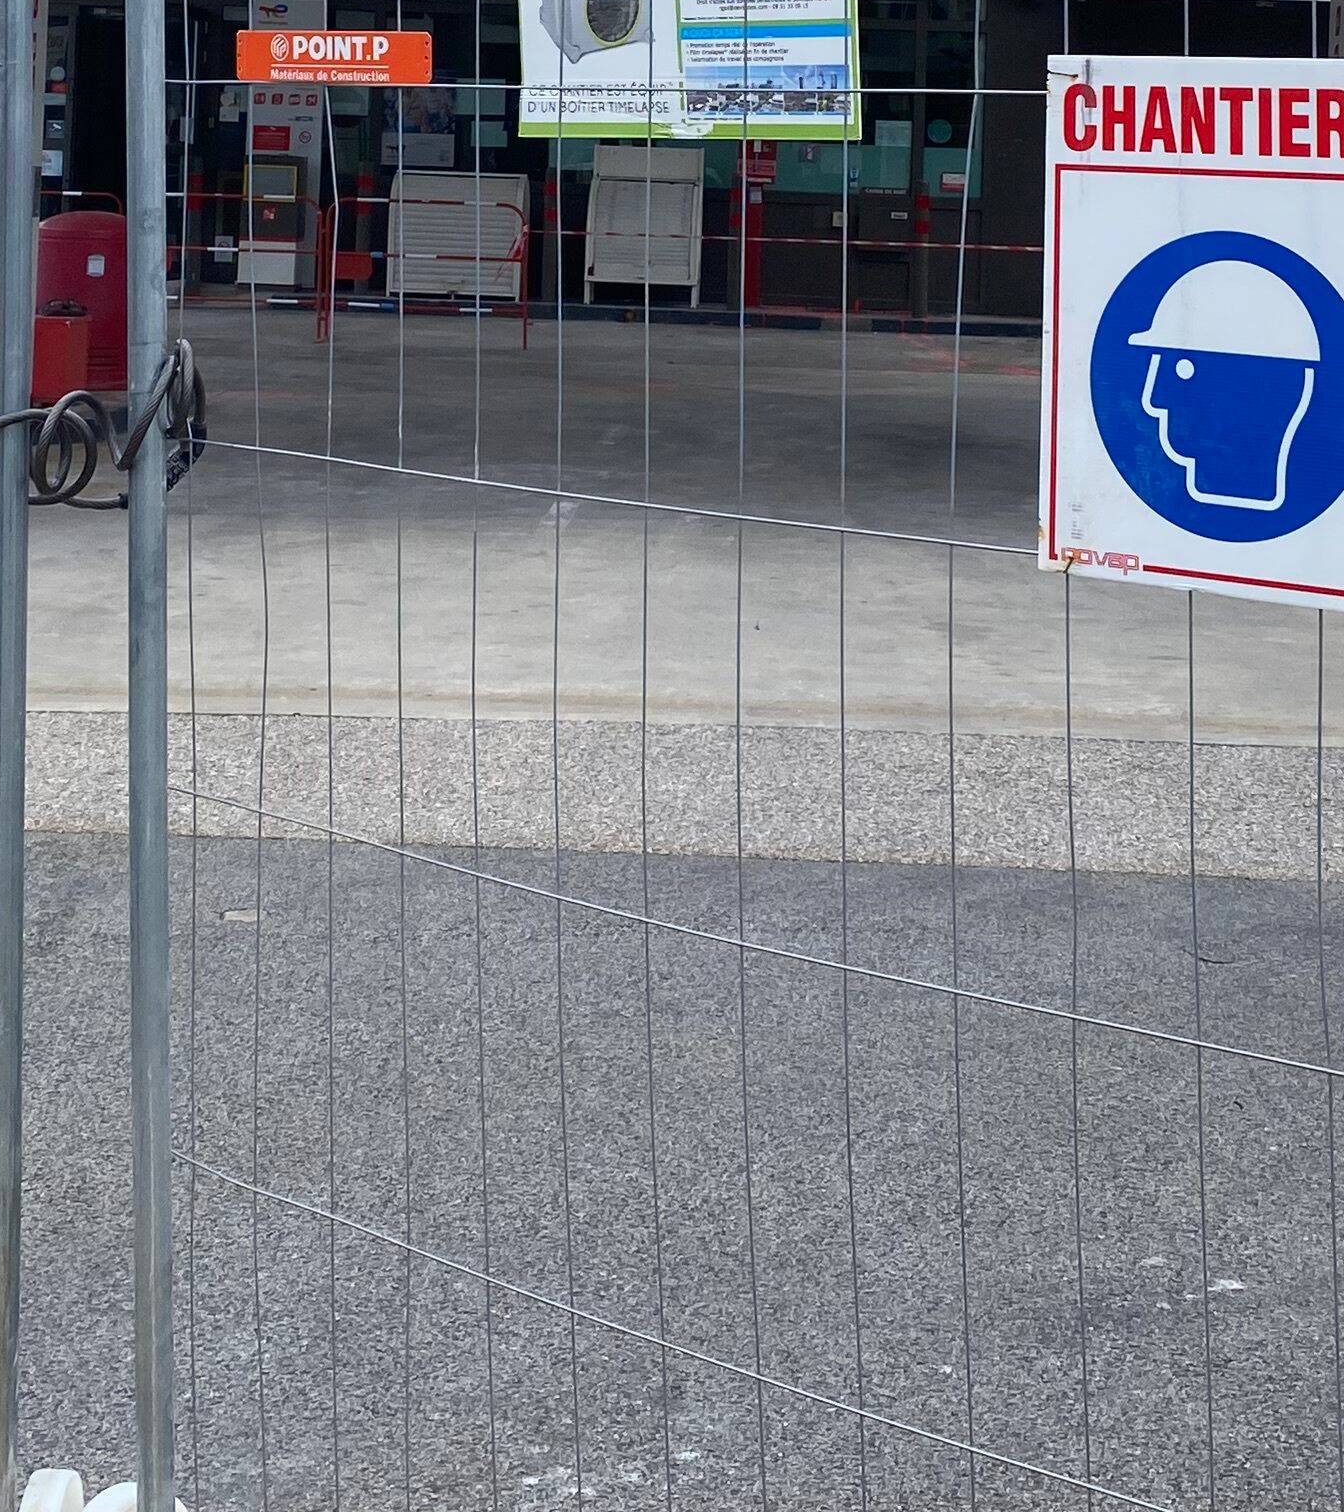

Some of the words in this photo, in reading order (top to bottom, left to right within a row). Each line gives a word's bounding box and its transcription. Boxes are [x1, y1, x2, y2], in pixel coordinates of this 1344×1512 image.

[292, 35, 390, 62] POINT.P
[316, 69, 328, 81] de
[330, 69, 390, 82] Construction
